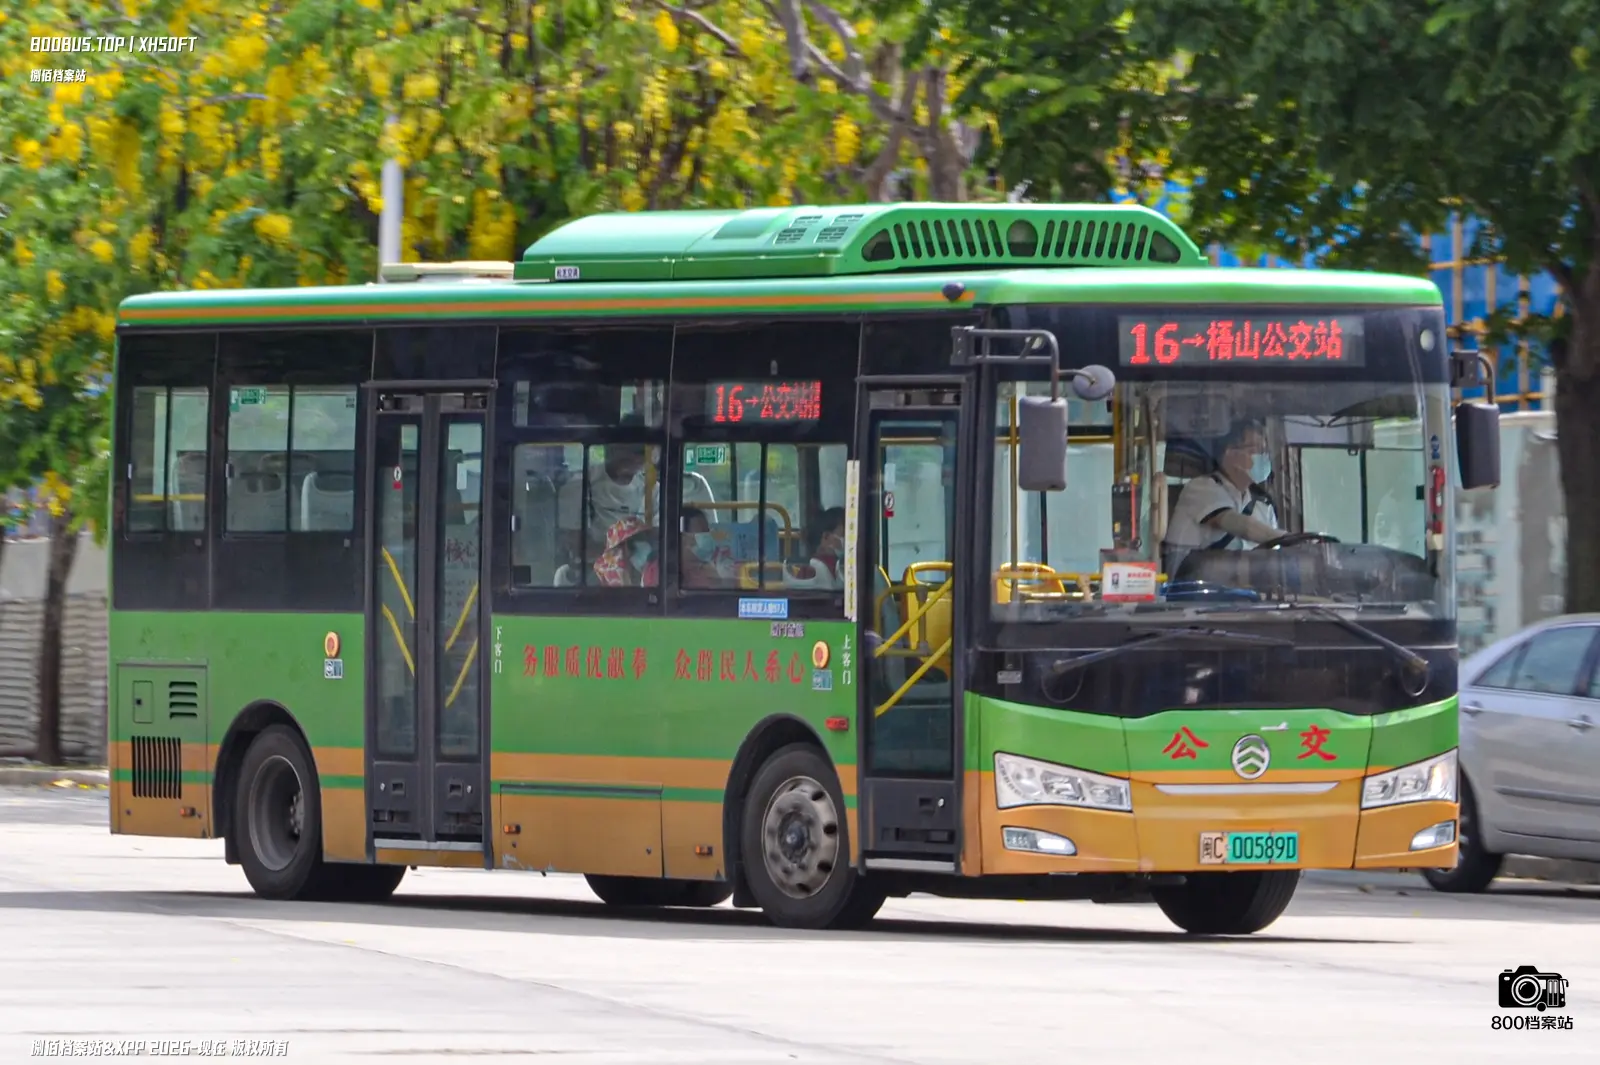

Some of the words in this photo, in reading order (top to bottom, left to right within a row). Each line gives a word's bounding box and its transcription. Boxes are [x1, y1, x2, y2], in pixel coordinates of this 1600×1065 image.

[1129, 322, 1181, 365] 16
[713, 384, 744, 422] 16
[494, 626, 502, 674] 下客门
[841, 634, 852, 685] 上客门
[1232, 836, 1297, 859] 00589D
